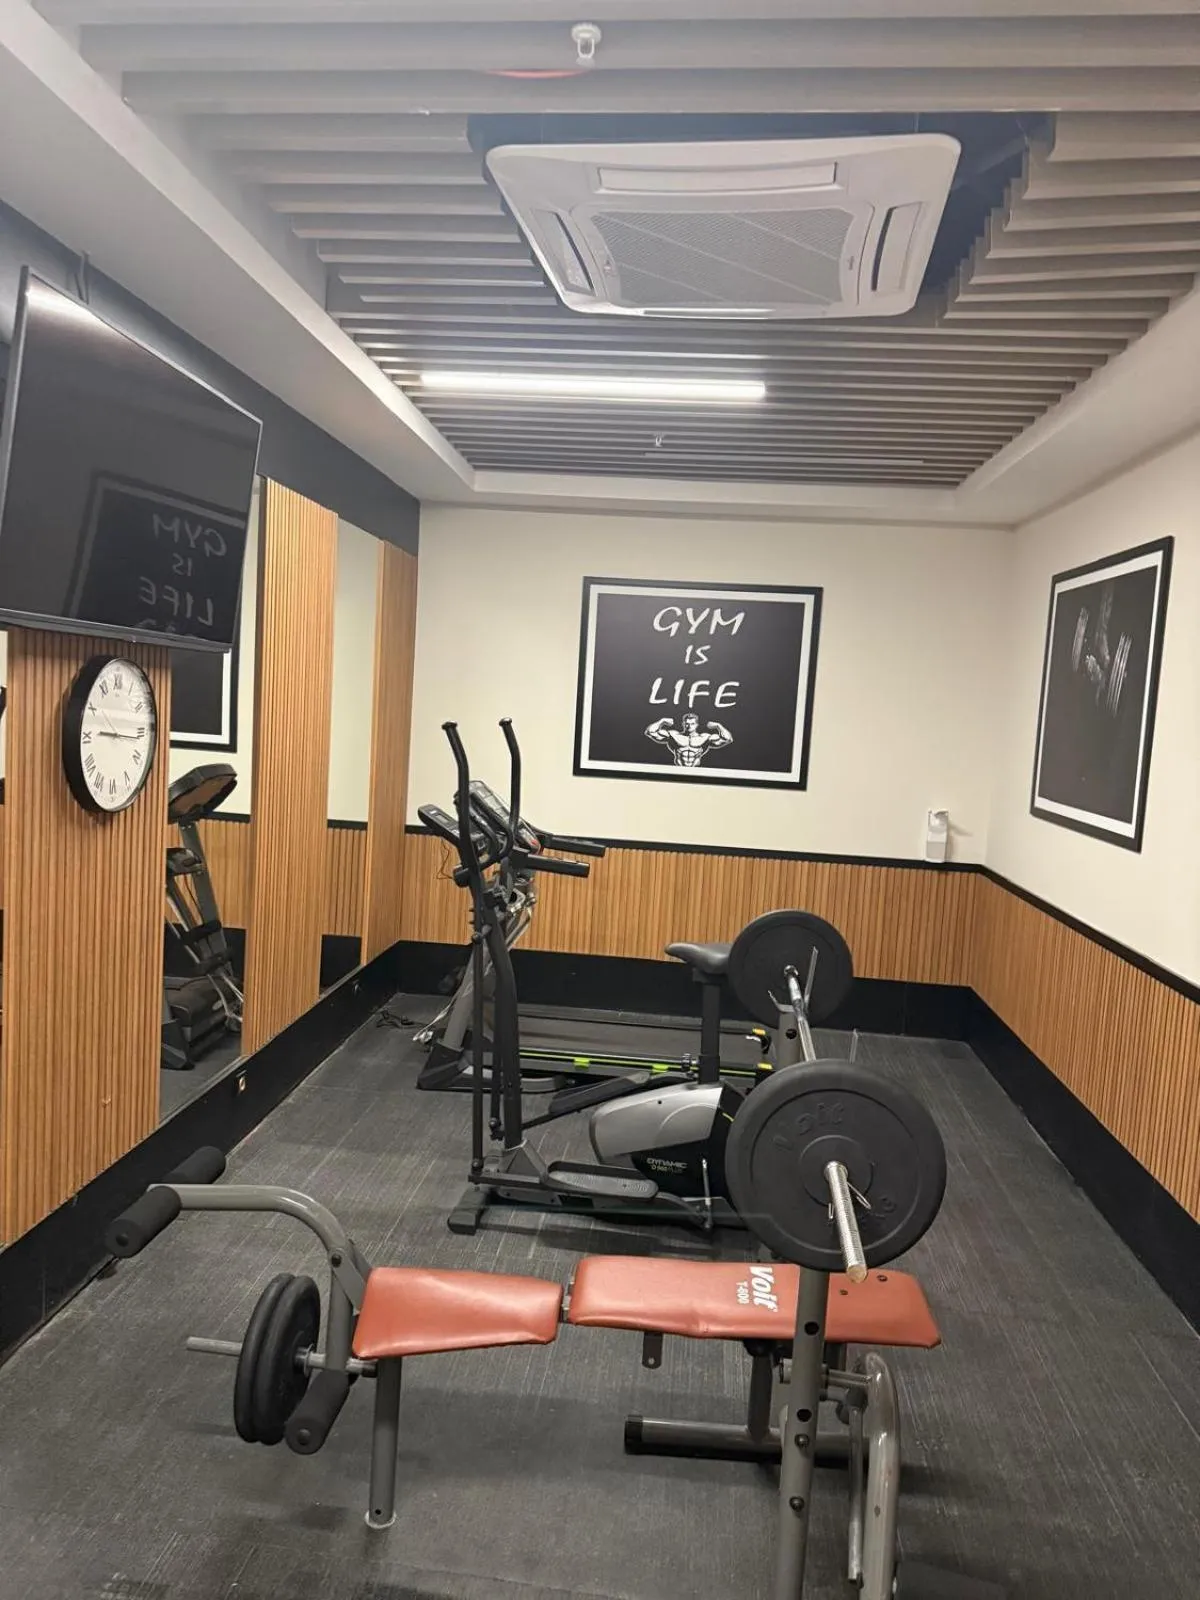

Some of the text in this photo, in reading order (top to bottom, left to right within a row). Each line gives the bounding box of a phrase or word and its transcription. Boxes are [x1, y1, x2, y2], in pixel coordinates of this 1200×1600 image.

[652, 606, 746, 637] GYM
[684, 644, 711, 665] IS
[648, 677, 740, 708] LIFE
[88, 701, 97, 717] X
[82, 730, 92, 744] IX
[646, 1157, 688, 1169] DYNAMIC
[749, 1265, 778, 1312] Voit
